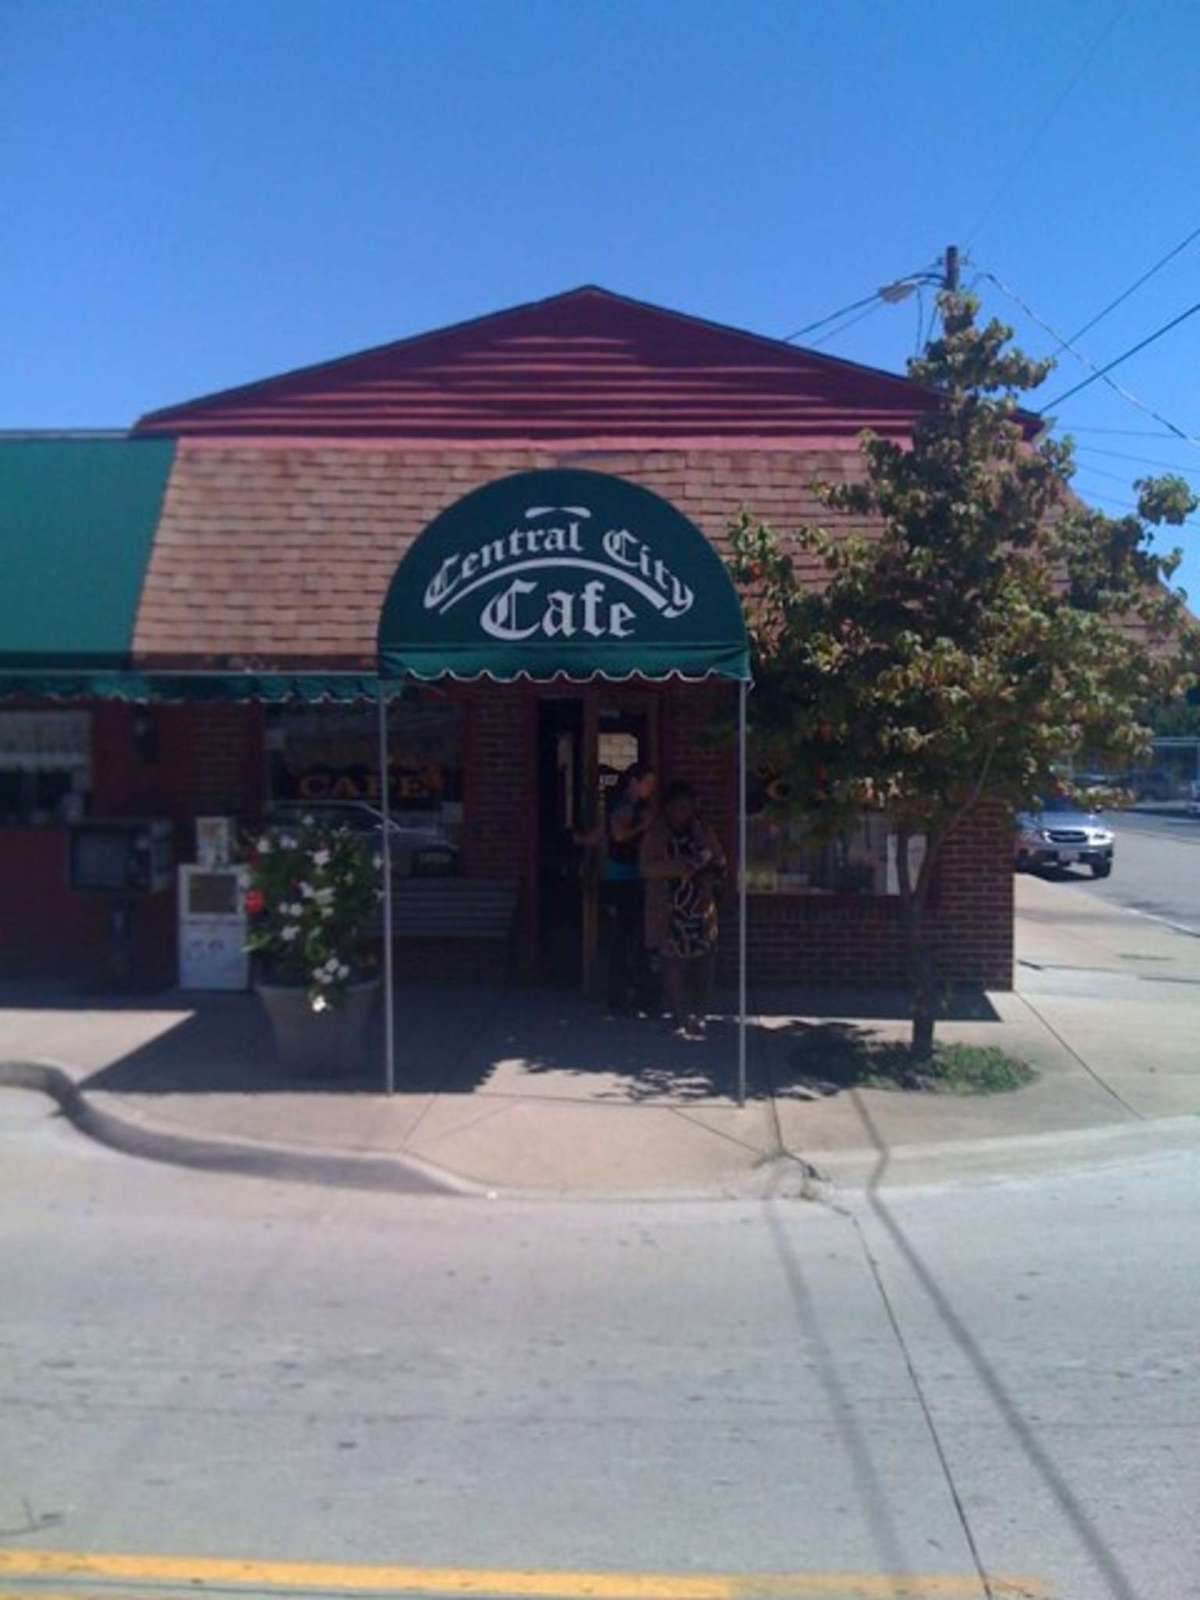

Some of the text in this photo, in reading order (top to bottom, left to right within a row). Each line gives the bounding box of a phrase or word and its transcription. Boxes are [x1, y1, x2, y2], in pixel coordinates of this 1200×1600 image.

[424, 522, 693, 618] Central City
[480, 579, 636, 640] Cafe
